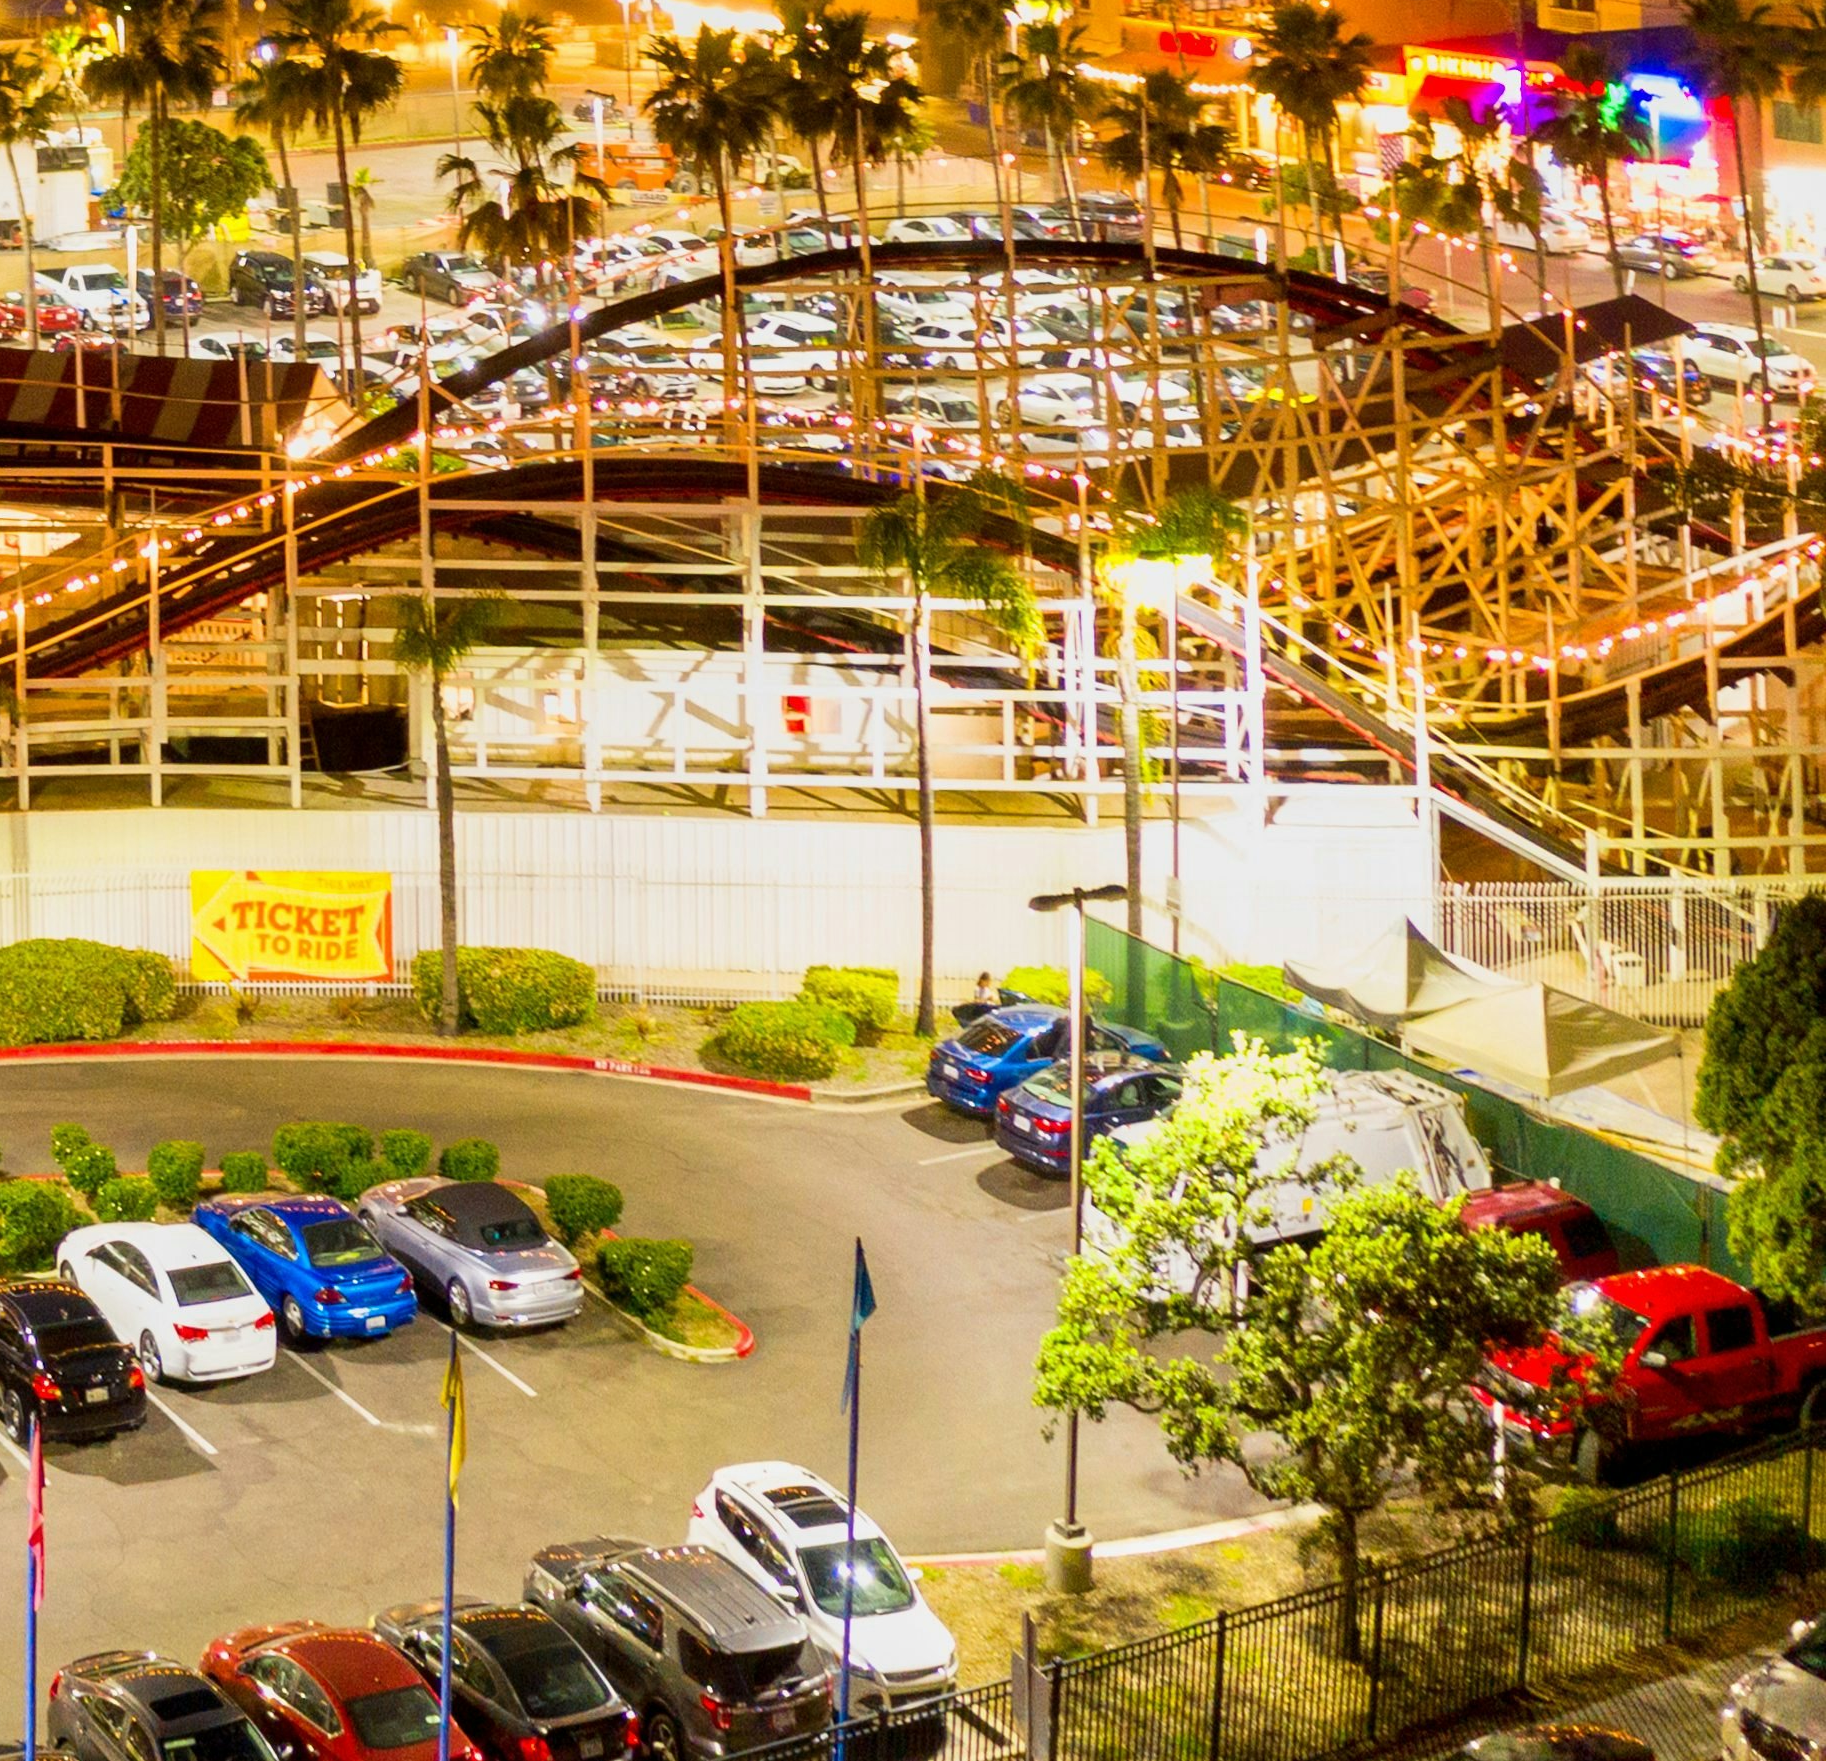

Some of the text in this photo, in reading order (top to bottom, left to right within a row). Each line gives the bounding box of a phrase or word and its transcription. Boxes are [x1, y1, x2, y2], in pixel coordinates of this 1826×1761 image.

[232, 900, 365, 937] TICKET
[257, 933, 359, 962] TO RIDE
